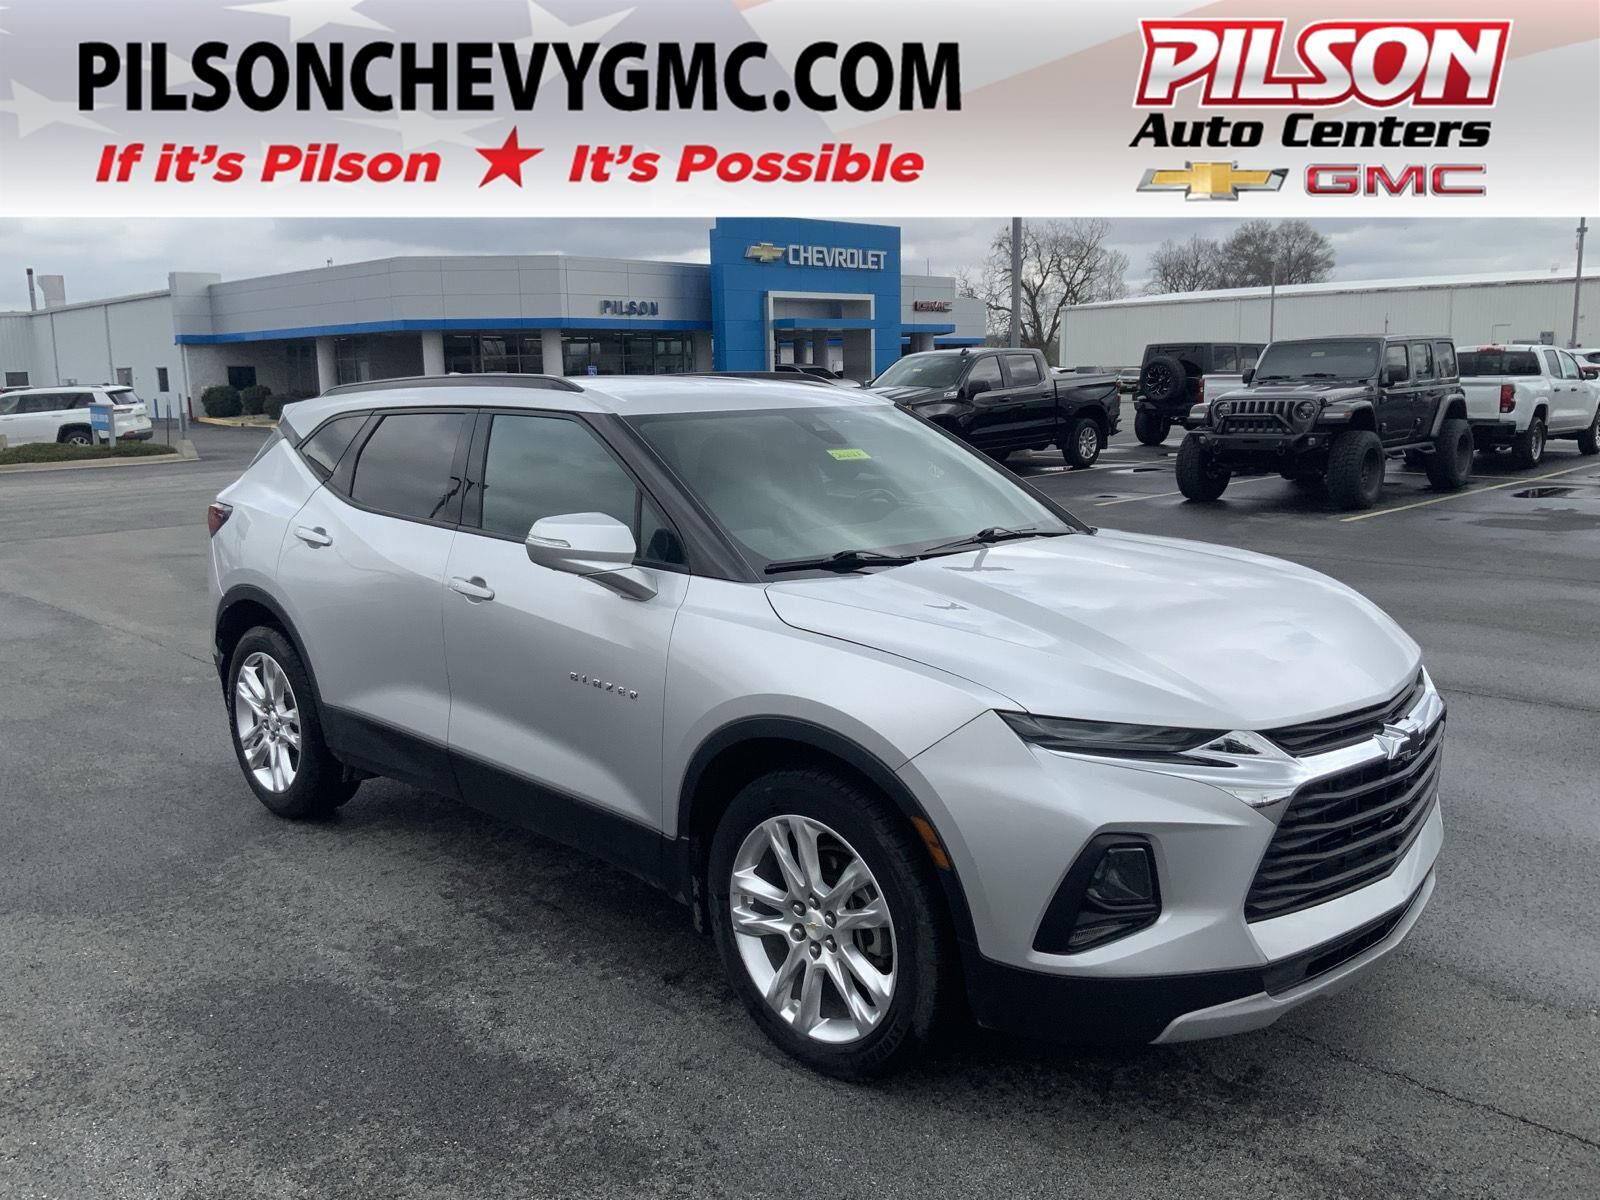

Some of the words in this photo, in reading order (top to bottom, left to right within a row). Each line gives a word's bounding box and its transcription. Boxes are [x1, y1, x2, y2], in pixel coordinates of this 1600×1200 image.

[788, 244, 887, 270] CHEVROLET
[600, 299, 659, 316] PILSON
[569, 671, 639, 701] BLAZER
